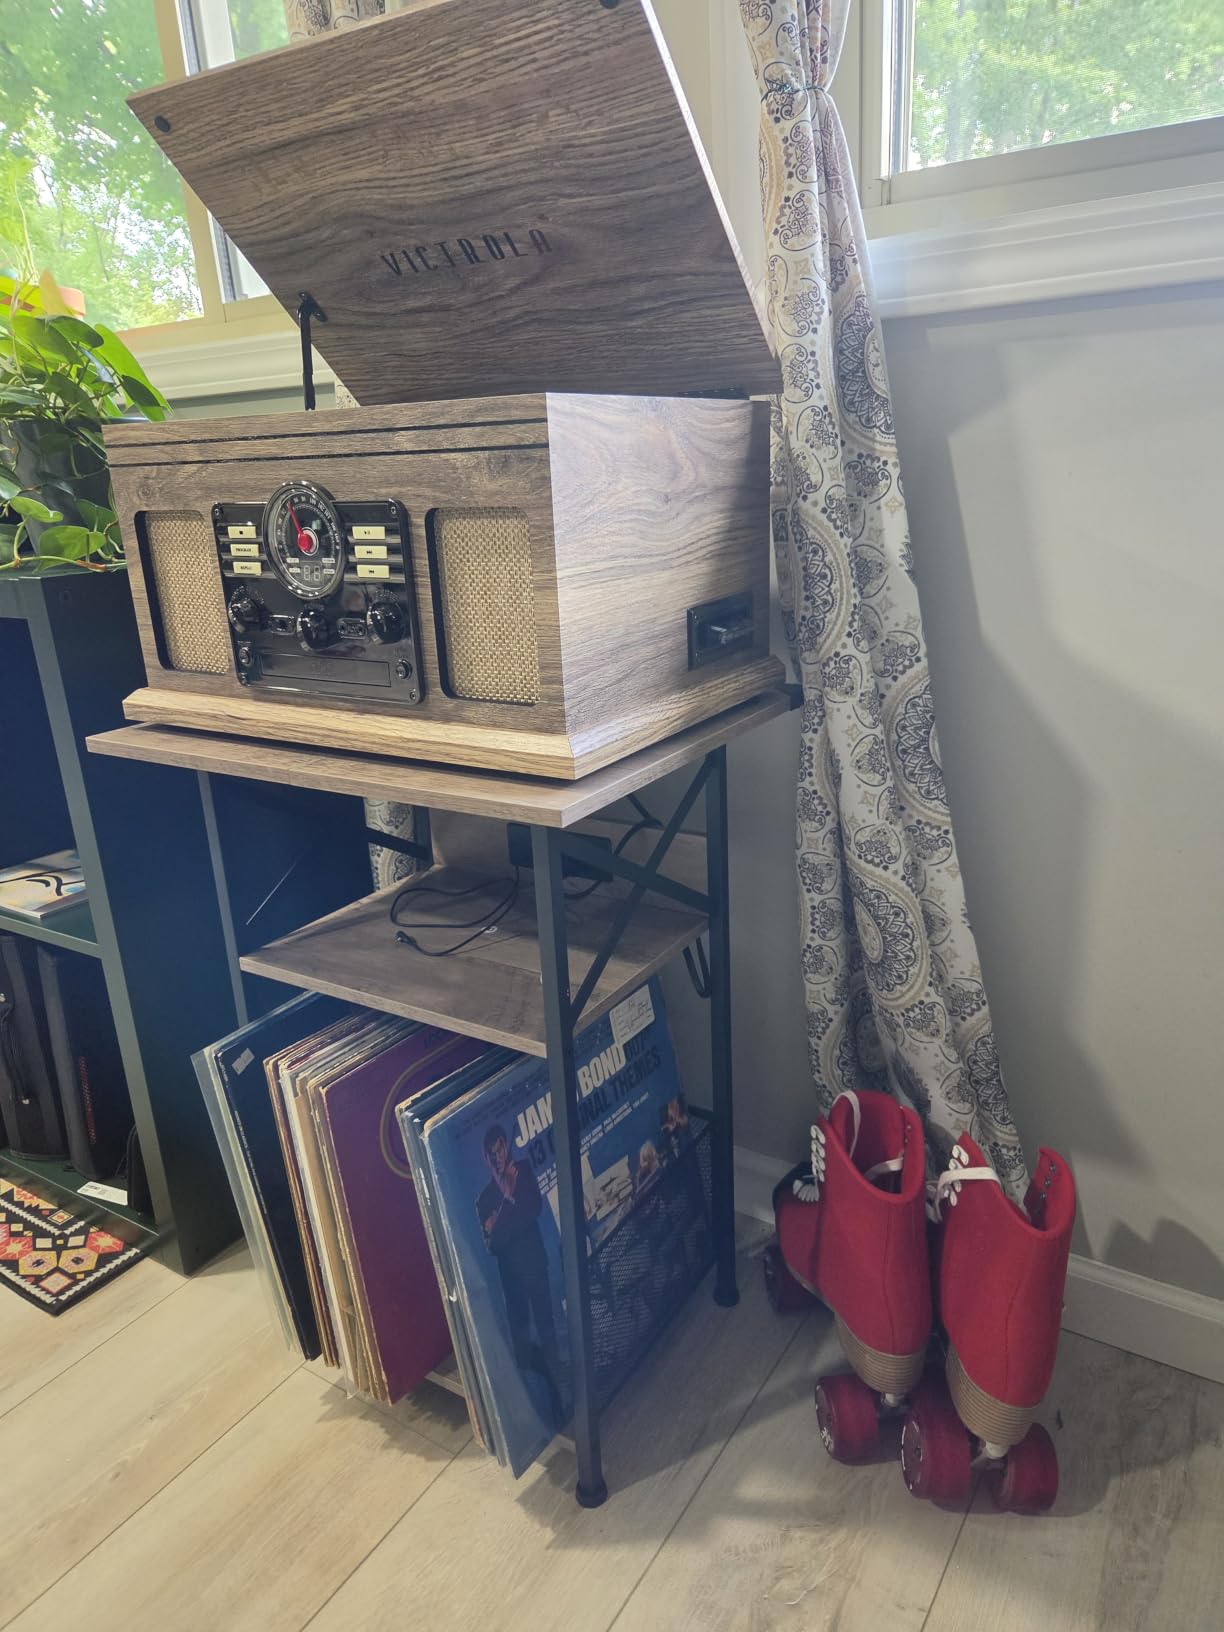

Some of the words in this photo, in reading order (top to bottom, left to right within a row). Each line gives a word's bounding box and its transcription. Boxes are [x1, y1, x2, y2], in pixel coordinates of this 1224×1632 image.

[381, 228, 553, 276] VICTROLA
[577, 1043, 626, 1098] BOND
[610, 1046, 662, 1101] THEMES
